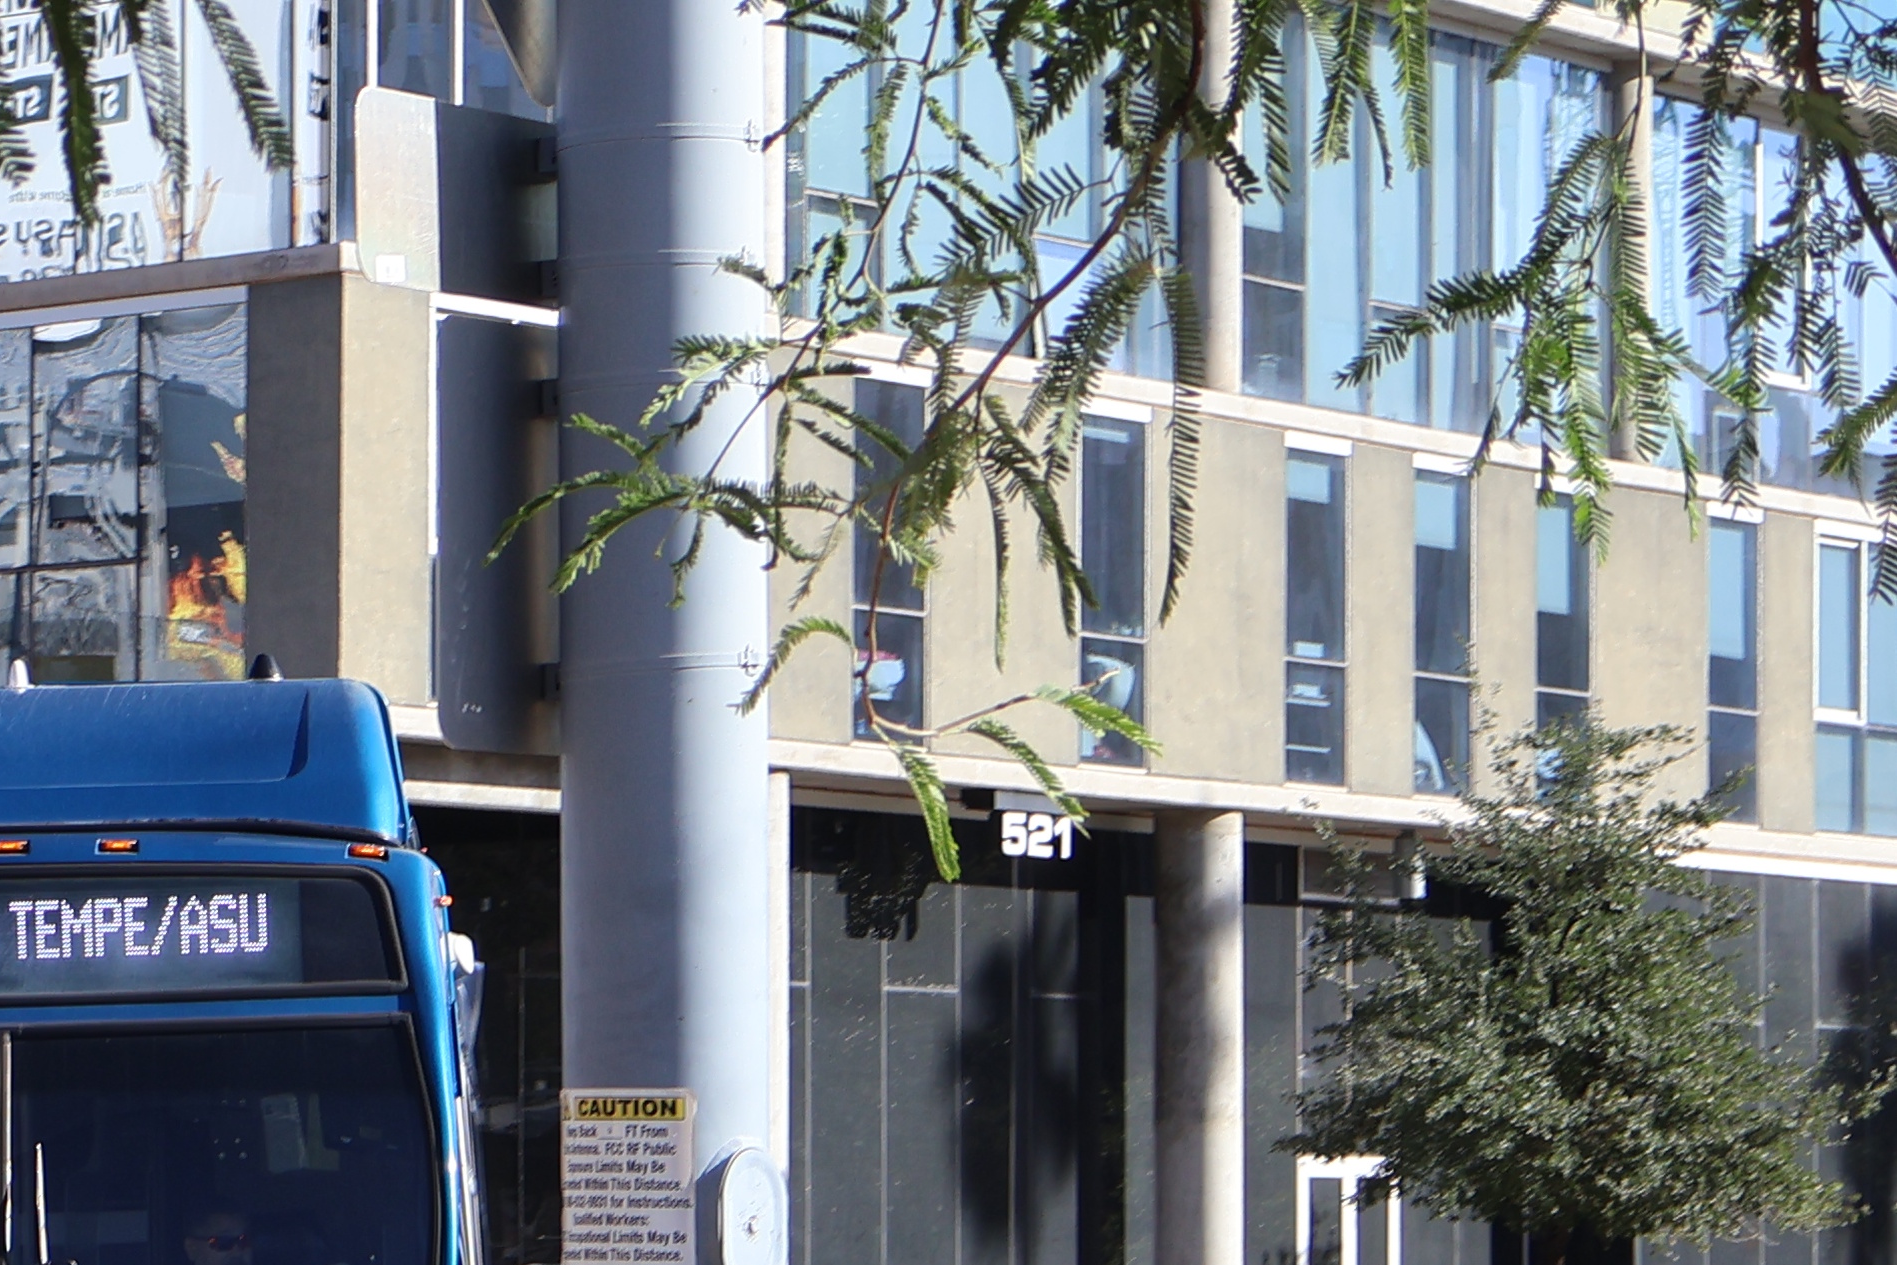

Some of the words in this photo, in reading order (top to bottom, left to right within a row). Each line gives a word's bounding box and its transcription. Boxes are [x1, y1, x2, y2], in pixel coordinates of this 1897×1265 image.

[1001, 811, 1073, 860] 521
[9, 893, 268, 959] TEMPE/ASU
[577, 1100, 678, 1117] CAUTION
[640, 1126, 669, 1138] From
[626, 1160, 648, 1175] May
[651, 1160, 665, 1173] Be
[611, 1178, 632, 1191] This
[610, 1195, 624, 1208] for
[647, 1231, 670, 1246] May
[672, 1231, 687, 1244] Be
[610, 1247, 631, 1261] This
